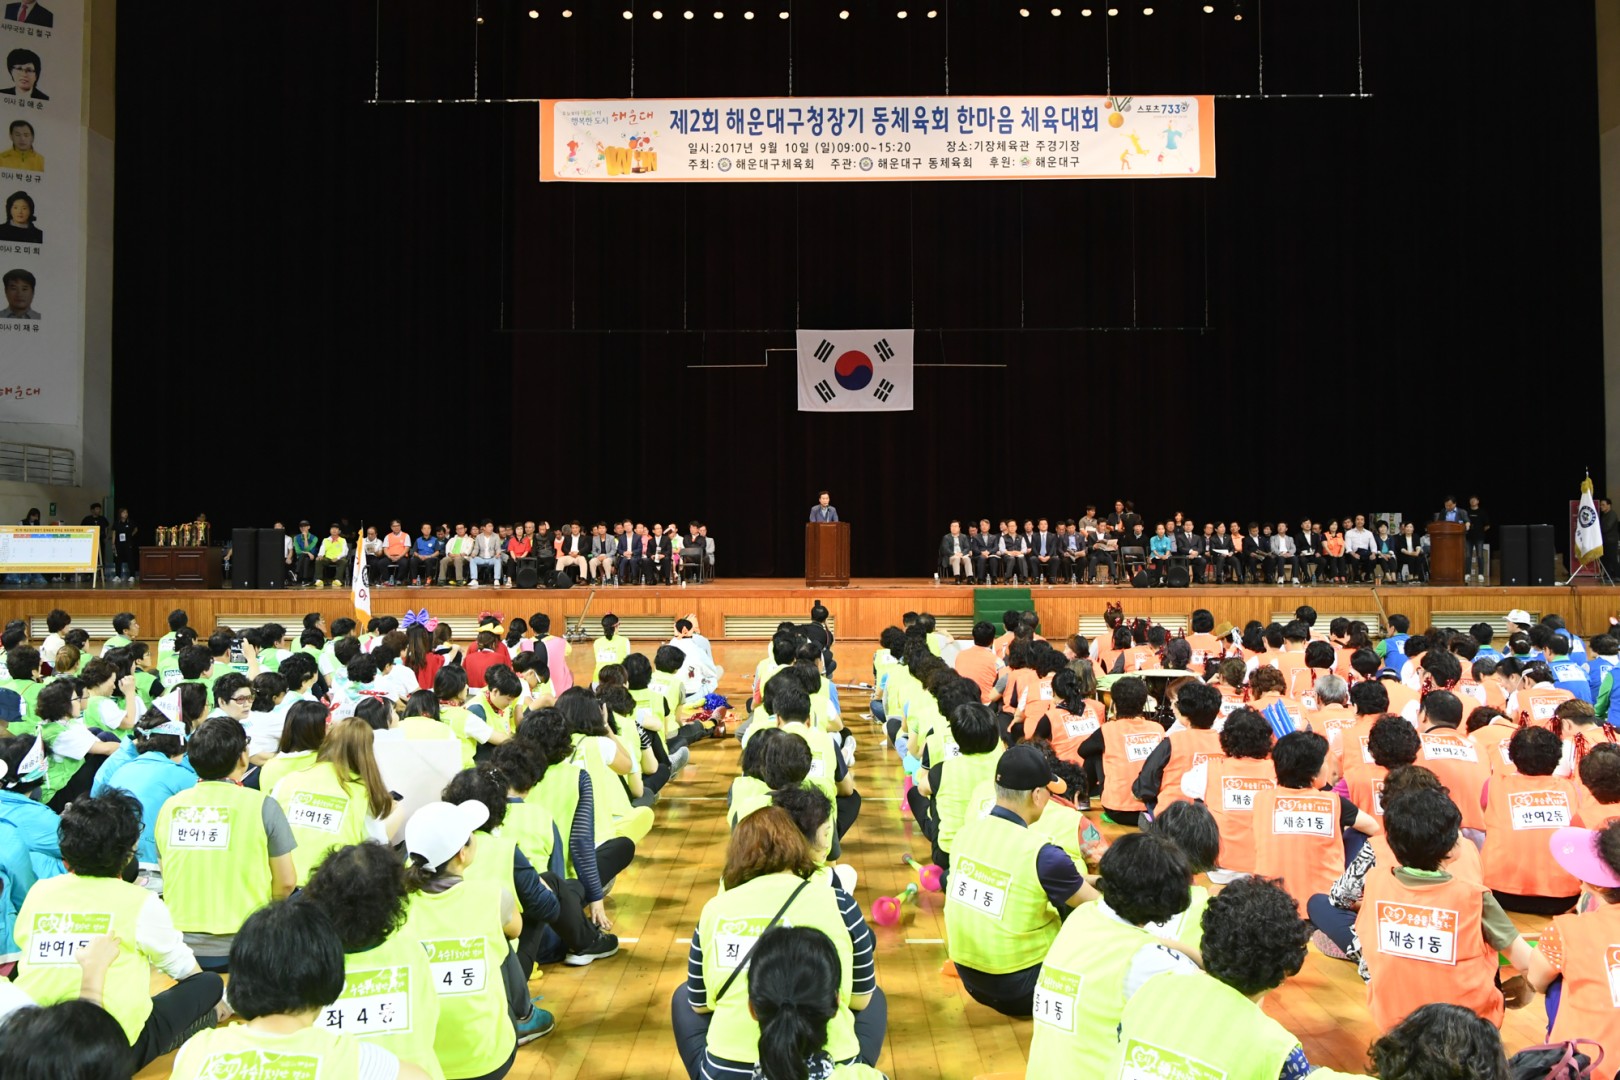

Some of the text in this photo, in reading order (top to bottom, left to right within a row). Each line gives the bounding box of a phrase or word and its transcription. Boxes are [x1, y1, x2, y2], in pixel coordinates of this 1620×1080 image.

[571, 109, 654, 126] 행복한 도시 해운대
[669, 105, 1099, 136] 제2회 해운대구청장기 동체육회 한마음 체육대회
[760, 142, 778, 154] 9월
[785, 142, 809, 154] 10일
[1036, 140, 1080, 152] 주경기장
[688, 156, 1080, 171] 주최: 해운대구체육회 주관: 해운대구 동체육회 후원: 해운대구
[1232, 794, 1252, 806] 재송
[1283, 816, 1325, 830] 재송1동
[1522, 810, 1564, 824] 반여2동
[1388, 930, 1442, 954] 재송1동
[461, 967, 475, 986] 동
[326, 1008, 345, 1030] 좌
